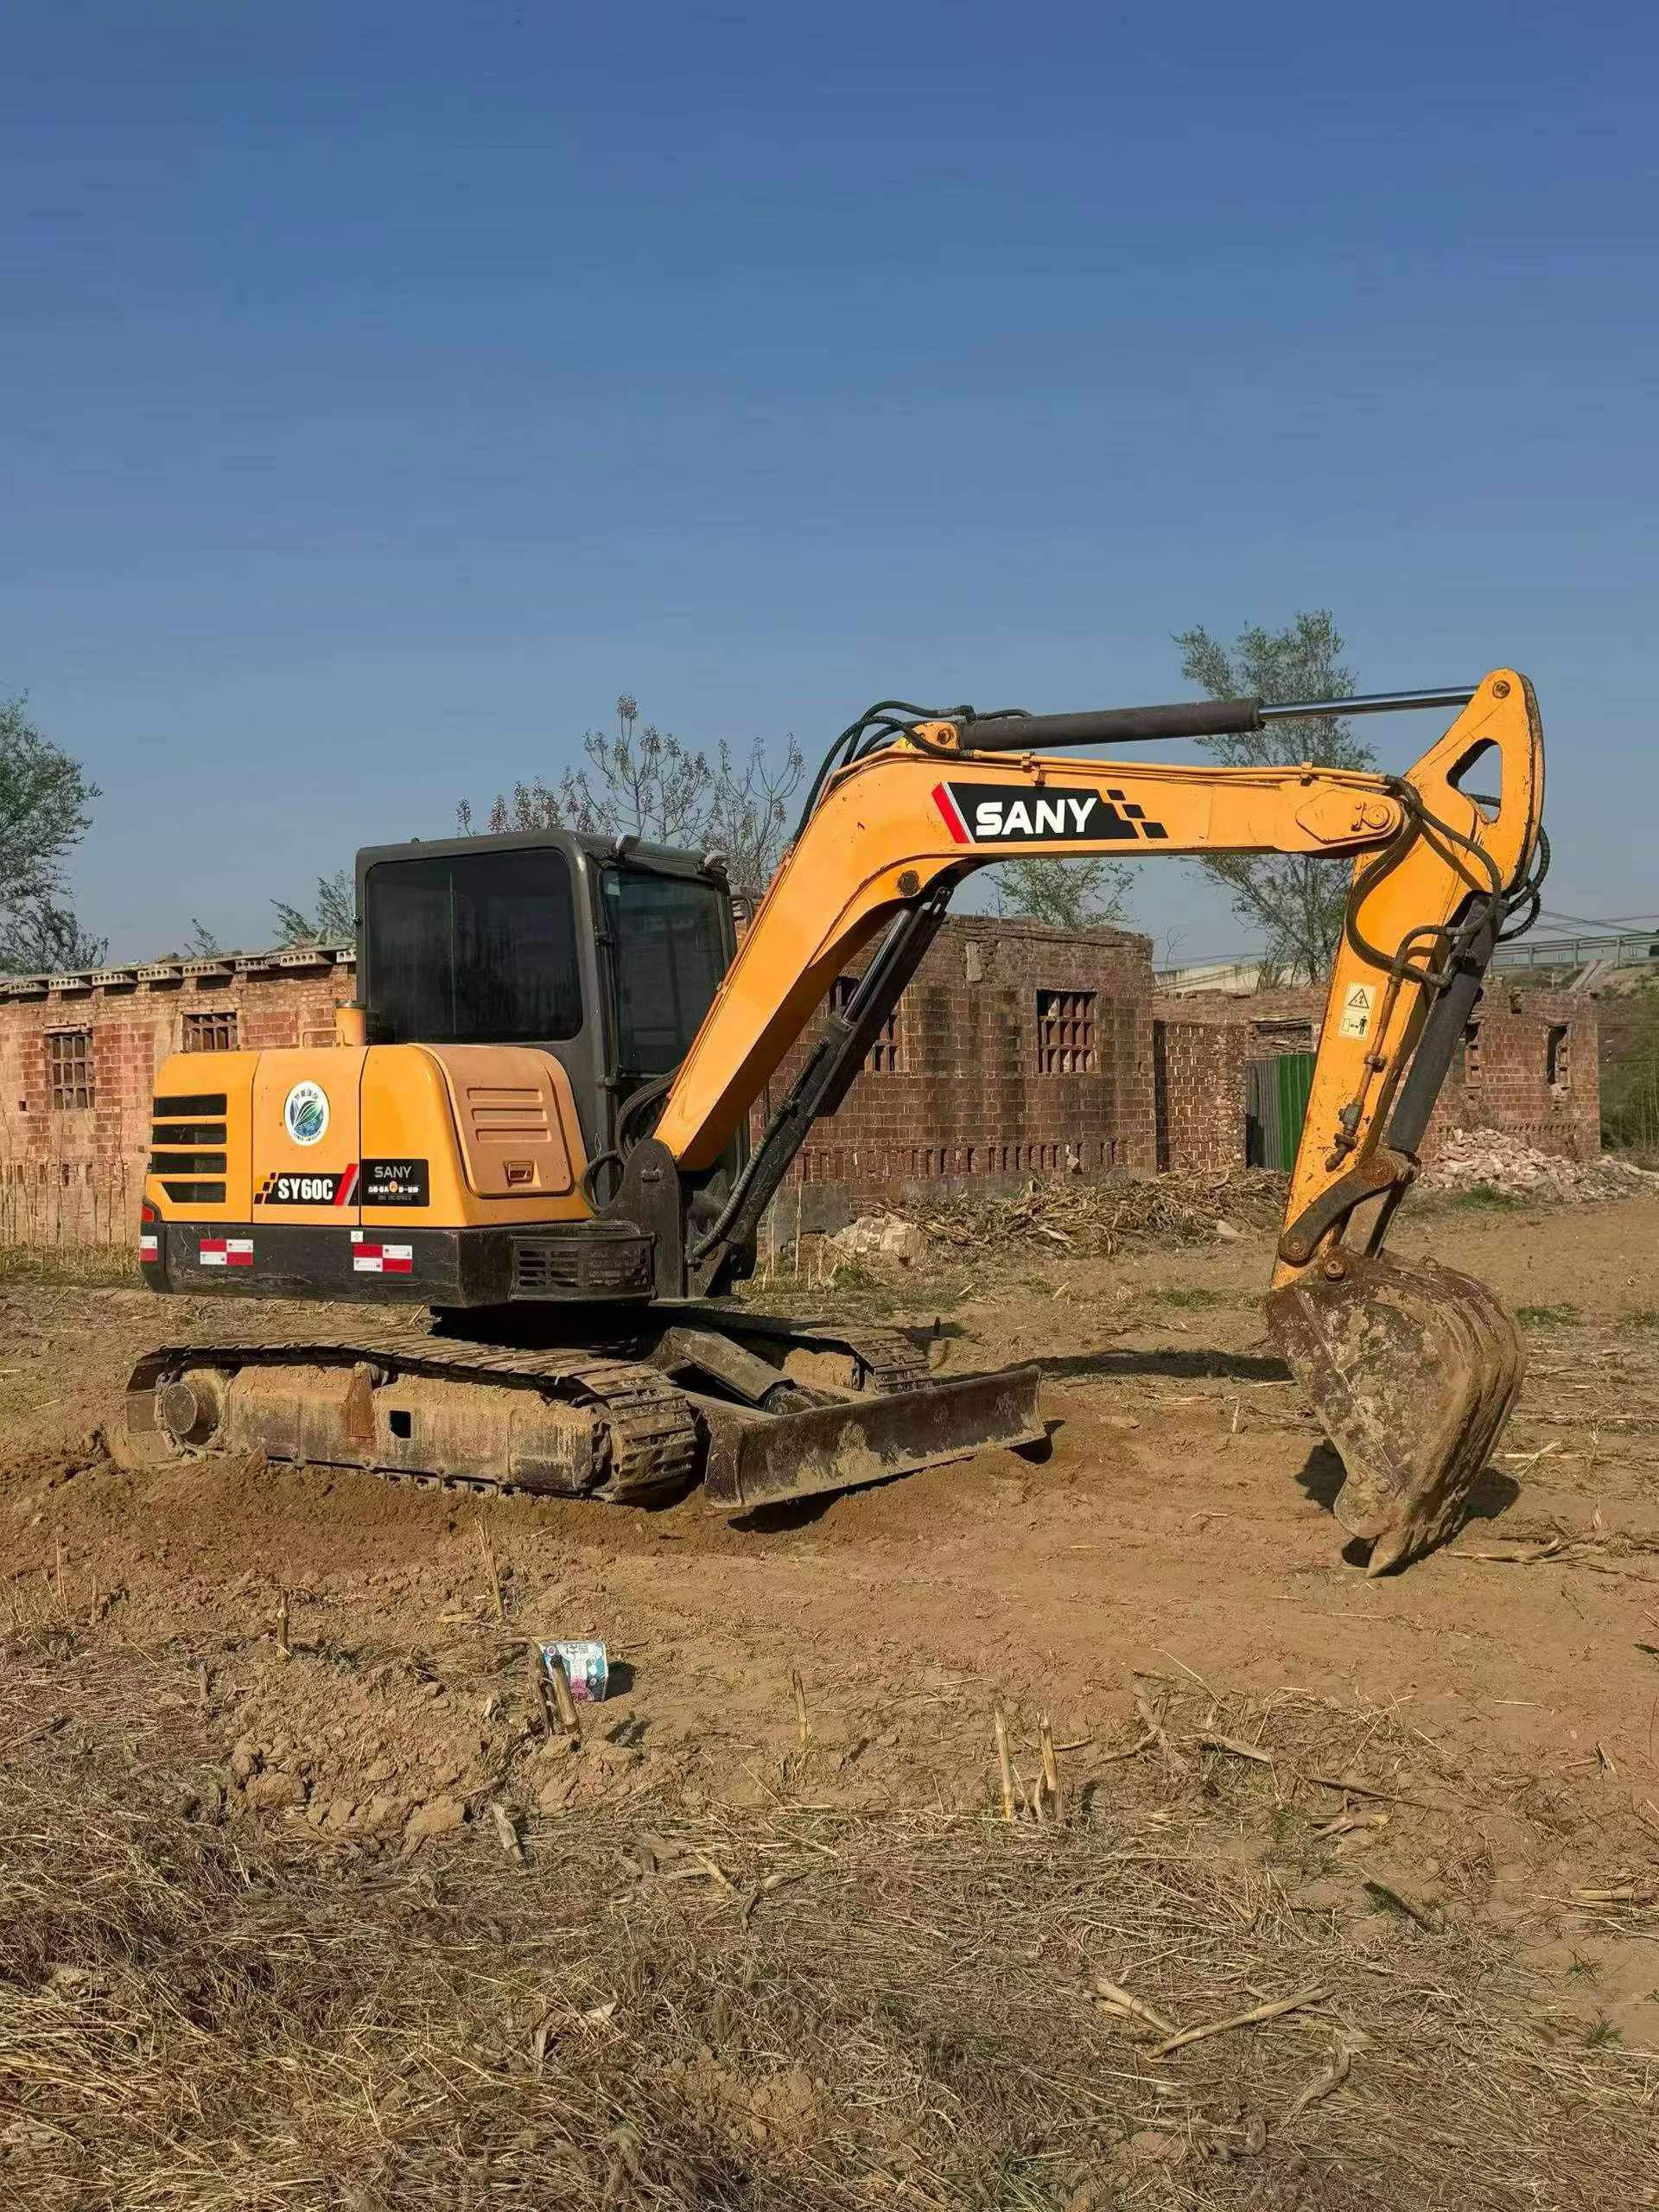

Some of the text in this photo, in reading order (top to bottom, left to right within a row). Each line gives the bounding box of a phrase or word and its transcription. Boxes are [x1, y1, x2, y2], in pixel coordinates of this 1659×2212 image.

[976, 798, 1097, 836] SANY
[374, 1166, 412, 1178] SANY
[277, 1178, 334, 1200] SY60C
